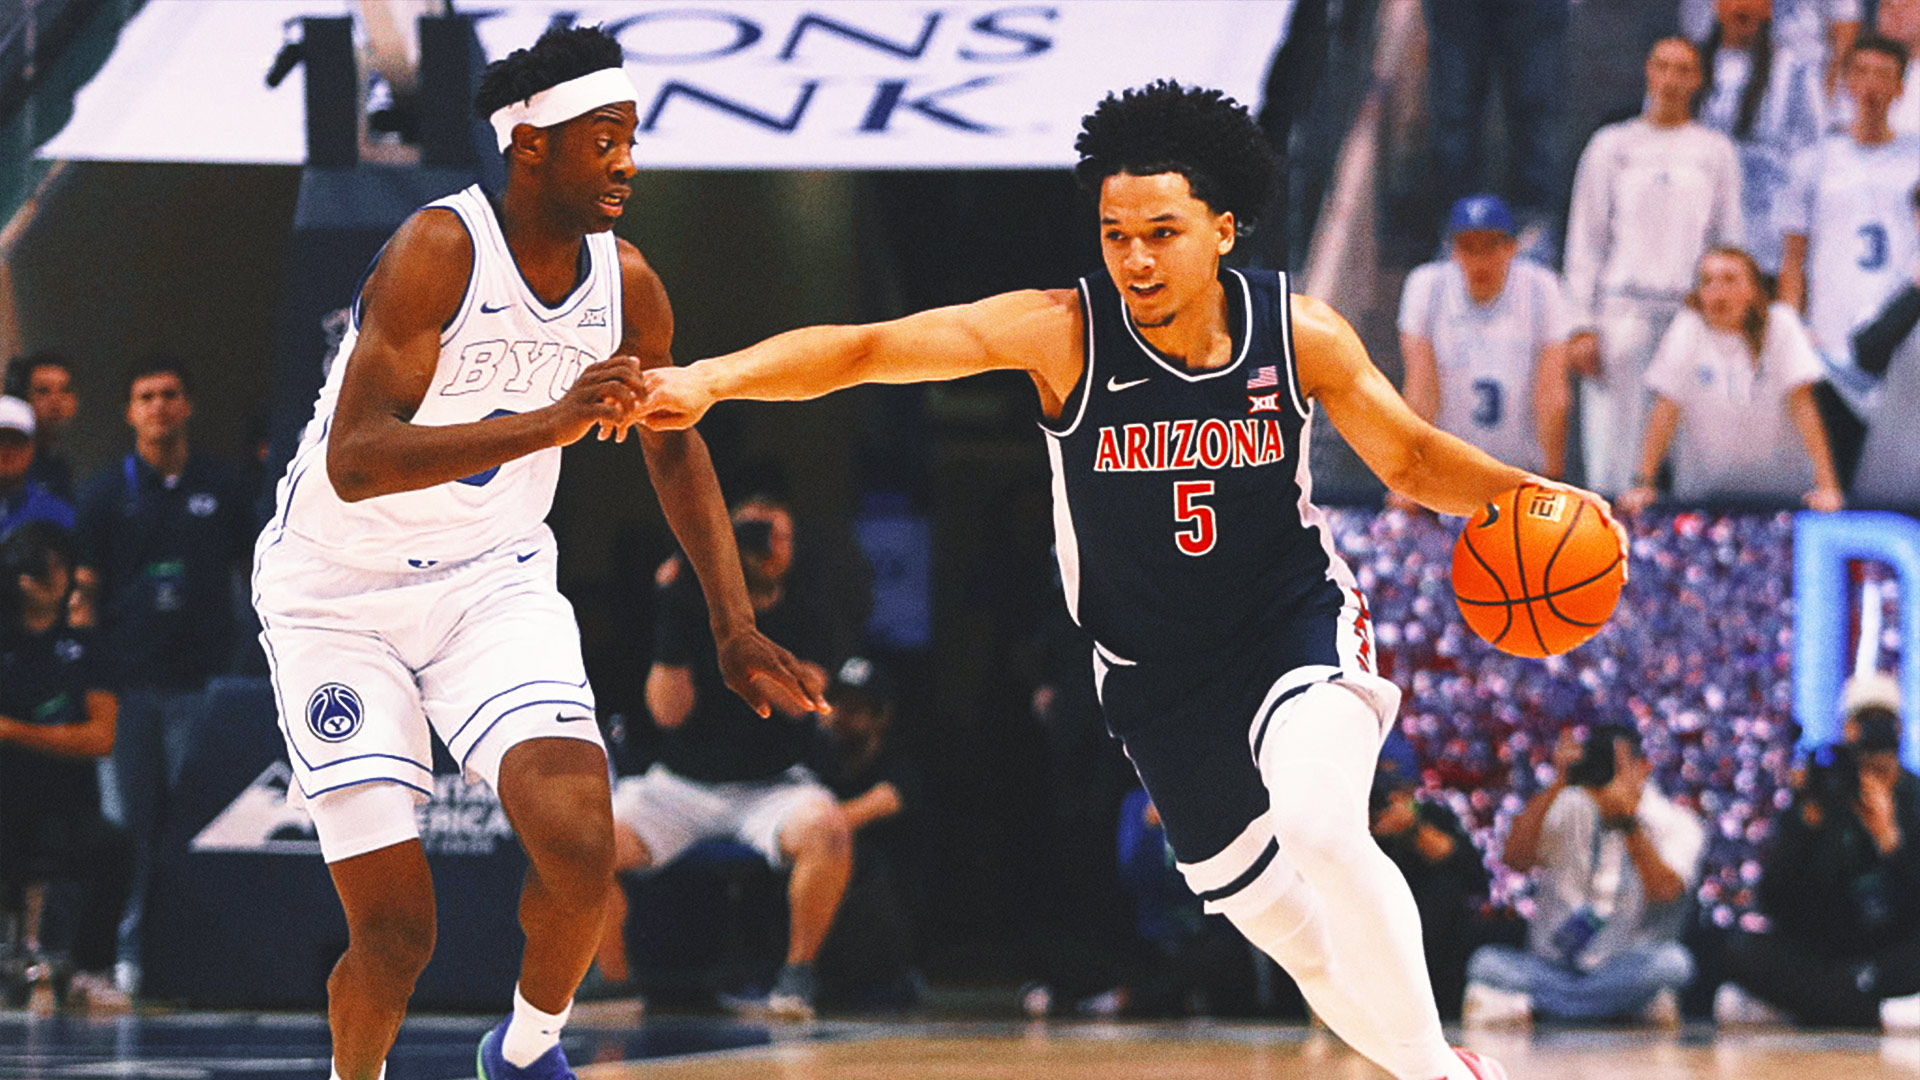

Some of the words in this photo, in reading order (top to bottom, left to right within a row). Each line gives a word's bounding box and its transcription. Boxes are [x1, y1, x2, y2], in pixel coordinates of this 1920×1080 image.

[456, 8, 1060, 64] ONS
[640, 74, 1008, 134] NK
[1857, 222, 1890, 271] 3
[440, 339, 598, 401] BYU
[1472, 378, 1503, 428] 3
[1094, 418, 1285, 472] ARIZONA
[1173, 480, 1217, 557] 5
